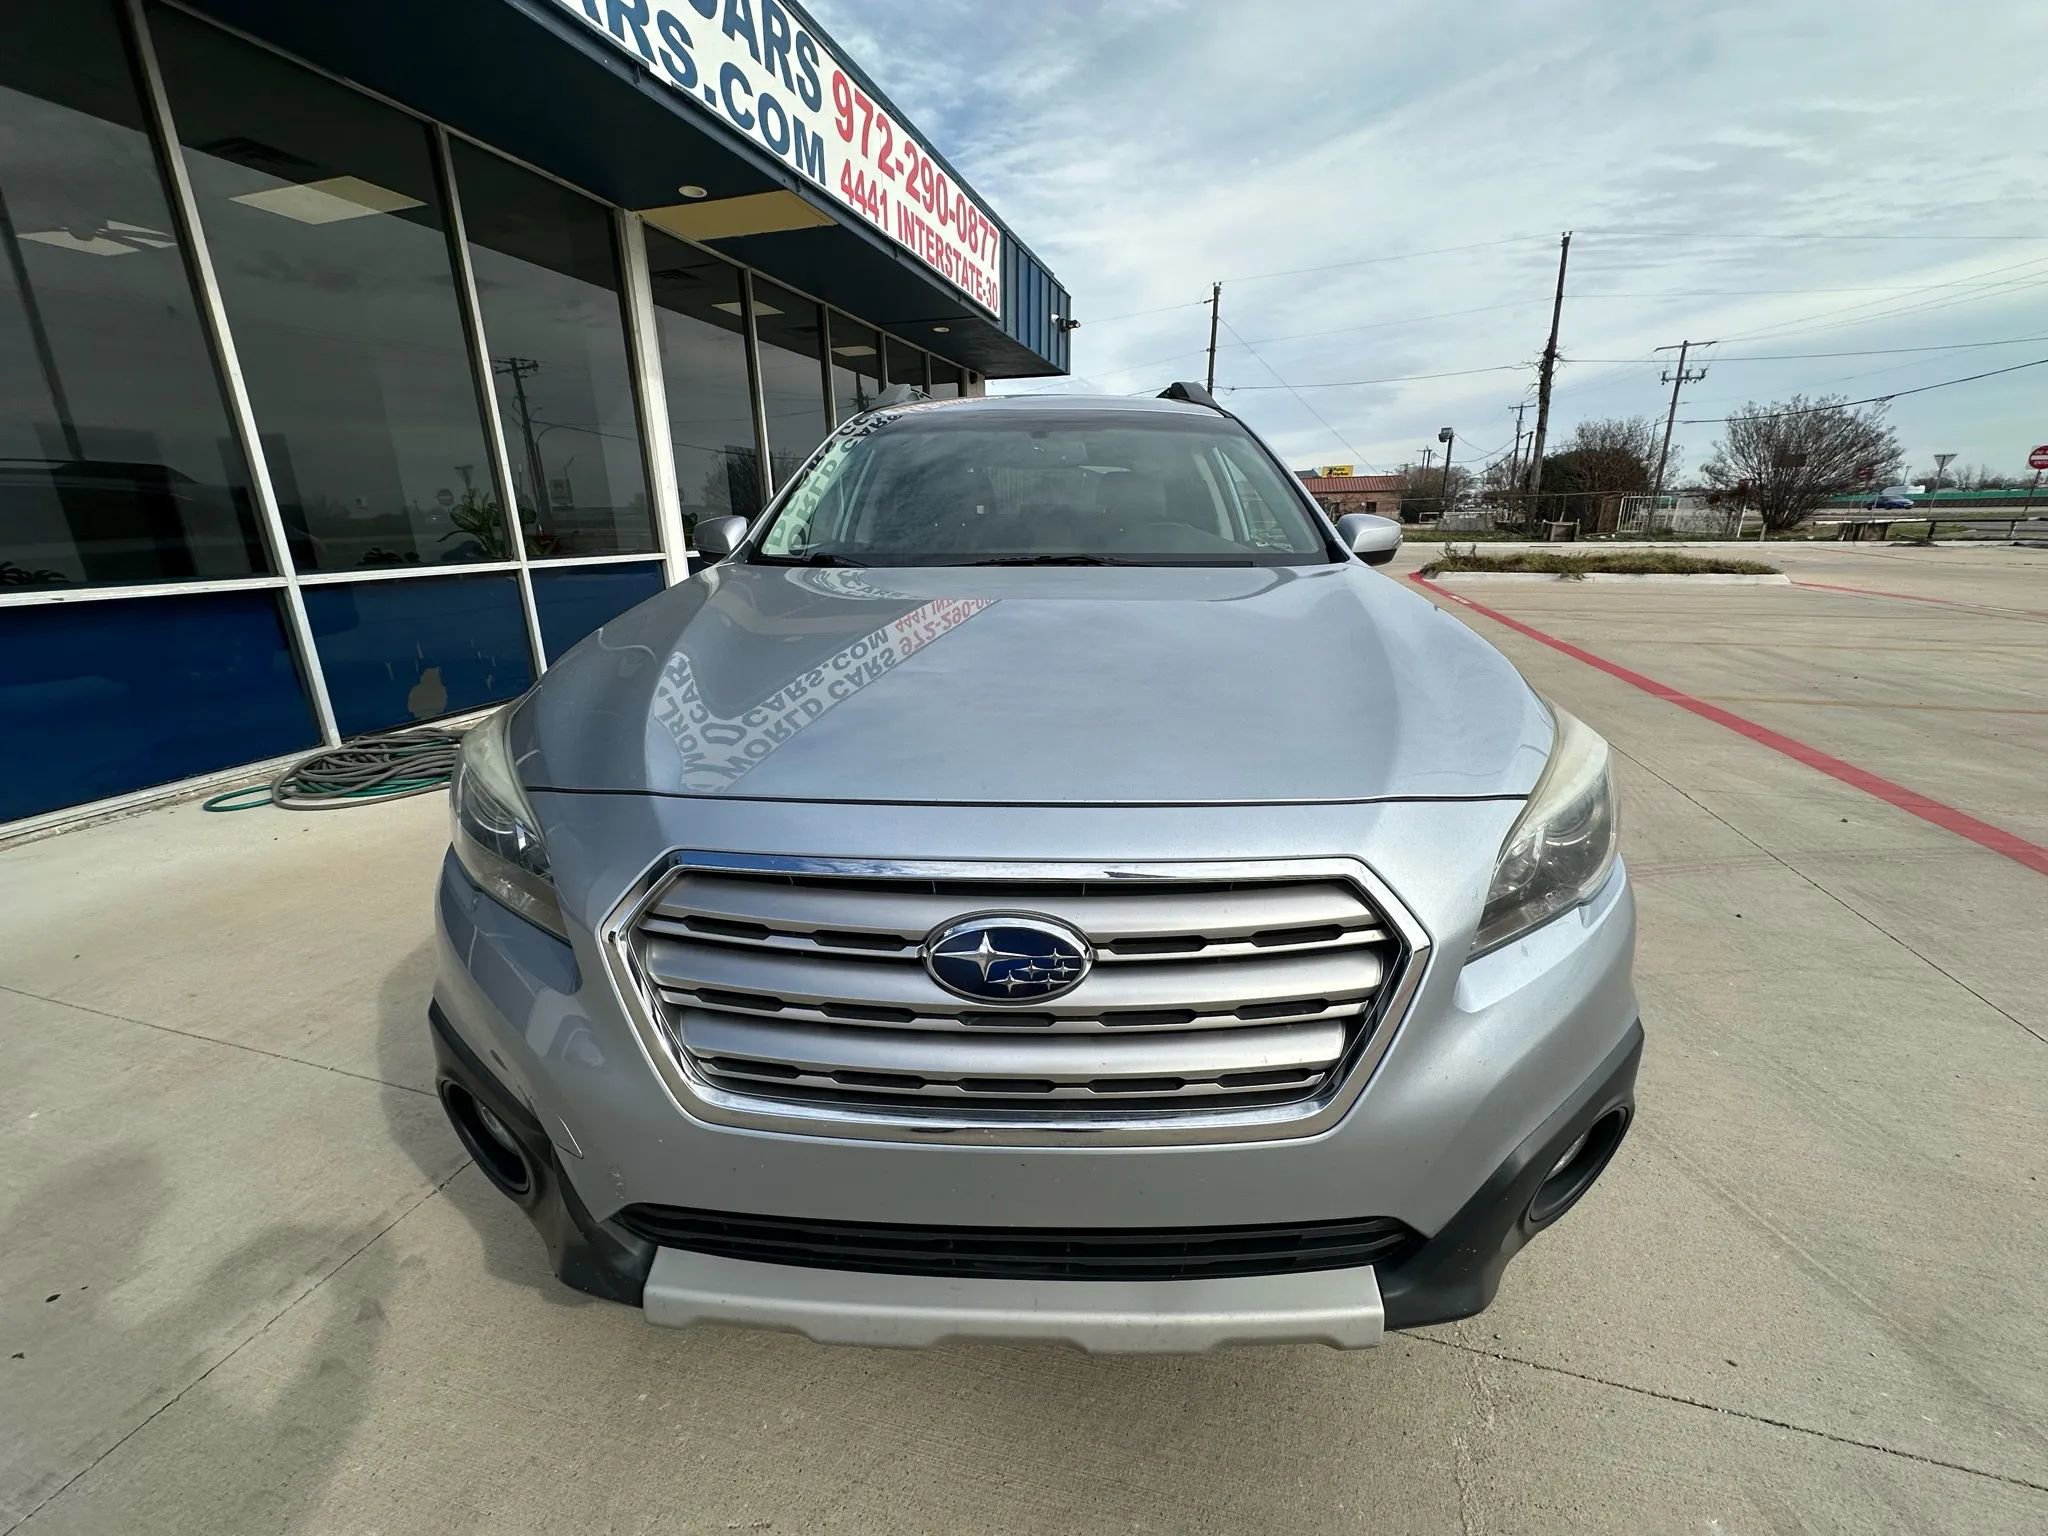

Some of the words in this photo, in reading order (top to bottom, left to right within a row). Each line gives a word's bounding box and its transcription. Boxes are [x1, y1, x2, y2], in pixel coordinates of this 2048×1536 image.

[832, 69, 999, 270] 972-290-0877
[840, 158, 889, 231] 4441
[897, 199, 999, 313] INTERSTATE-30
